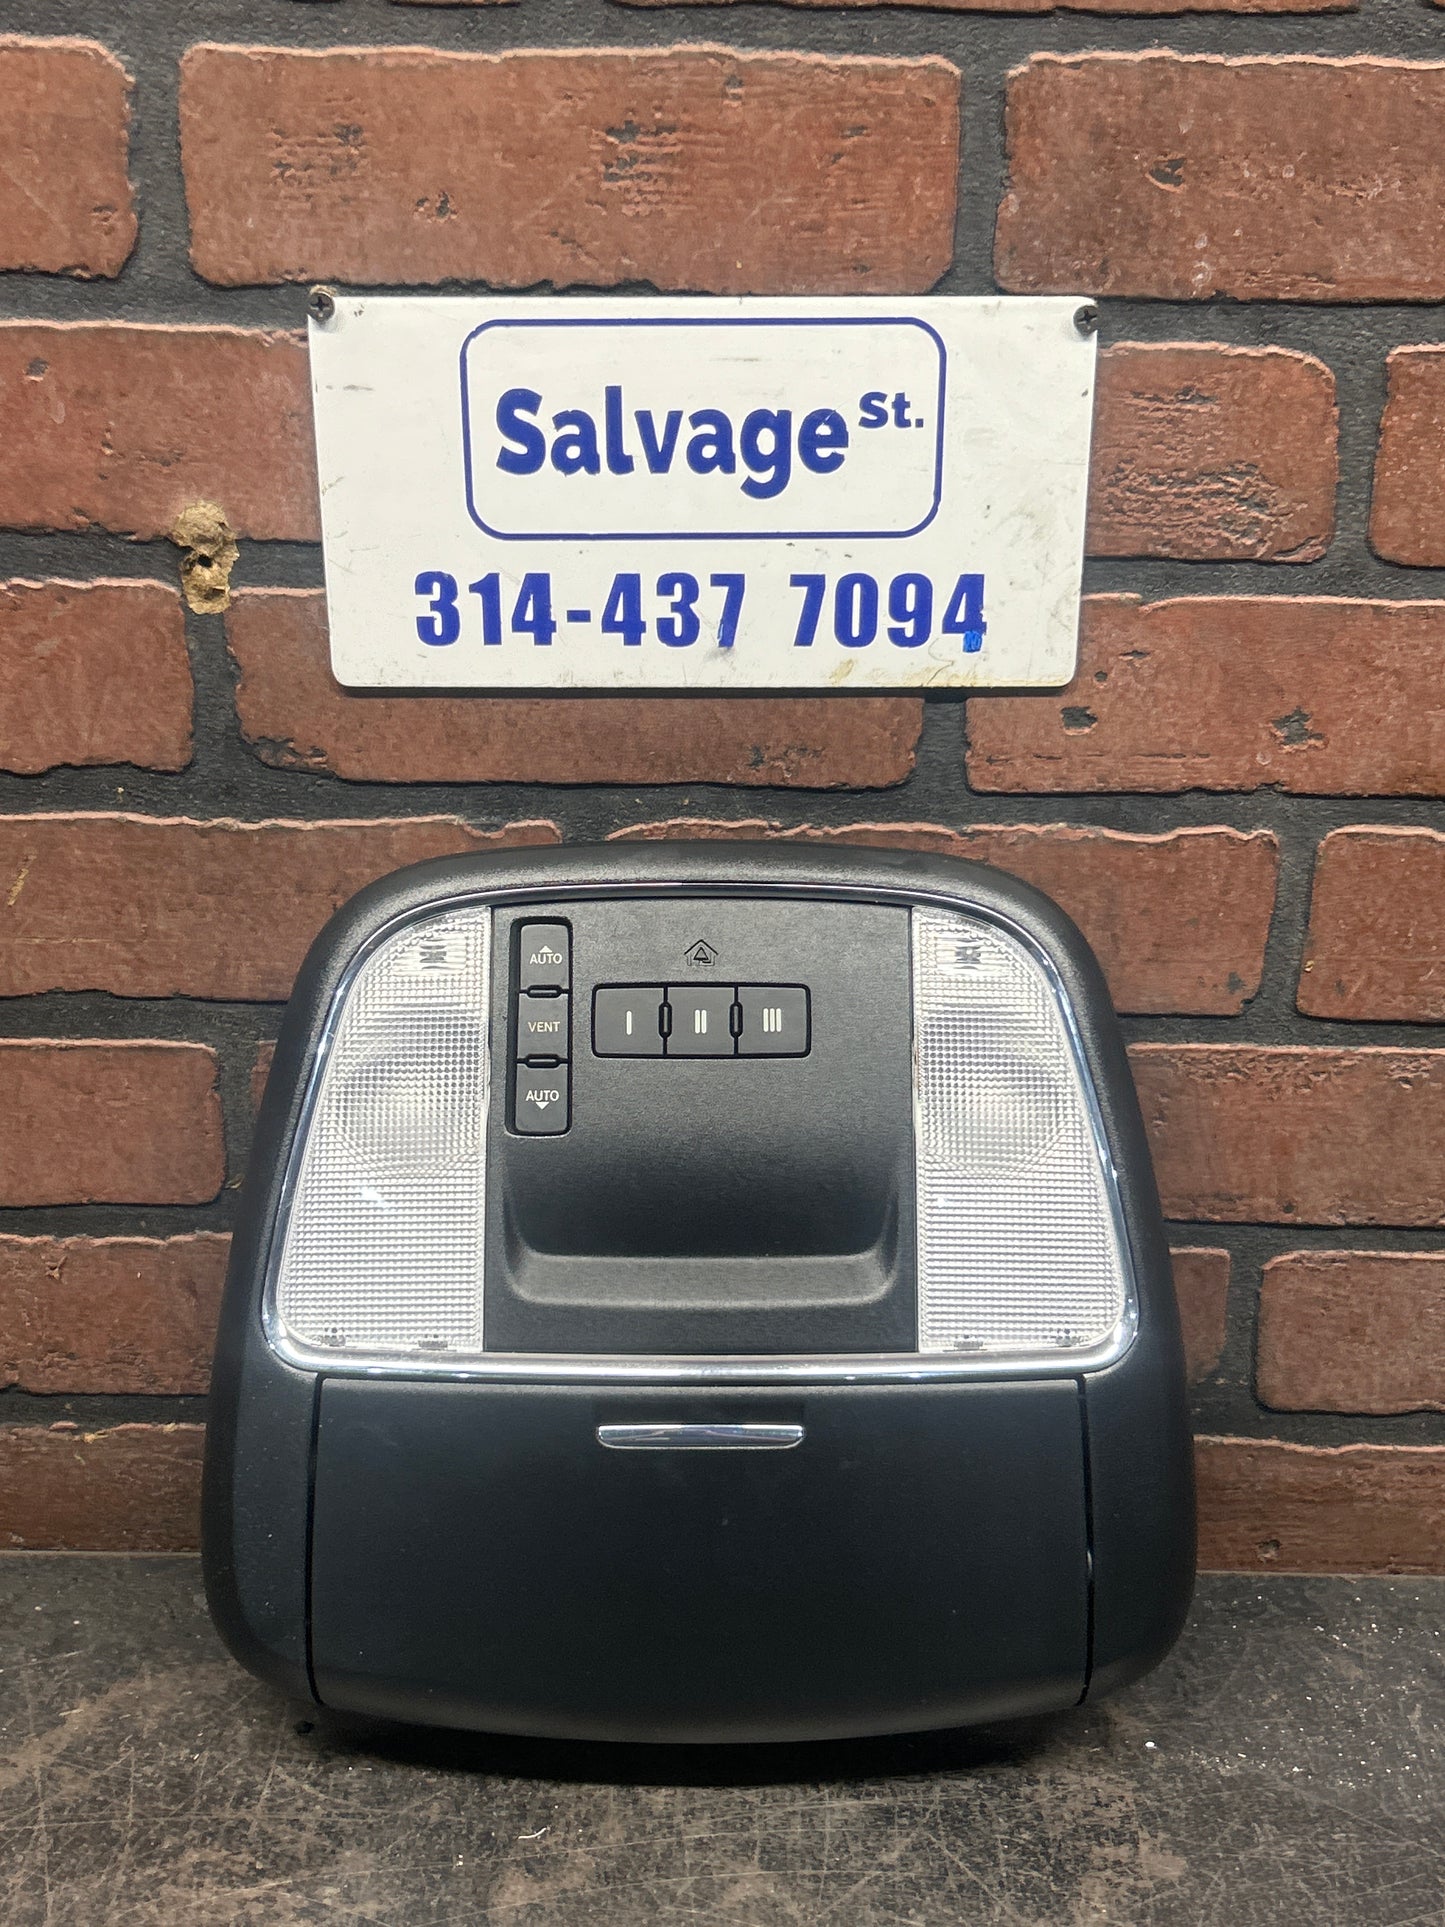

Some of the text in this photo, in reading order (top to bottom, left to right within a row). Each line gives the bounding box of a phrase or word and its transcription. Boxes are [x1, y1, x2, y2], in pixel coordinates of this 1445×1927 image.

[495, 385, 925, 500] Salvage St.
[415, 571, 987, 651] 314-437 7094
[529, 953, 563, 965] AUTO
[527, 1021, 561, 1033] VENT
[525, 1090, 560, 1102] AUTO
